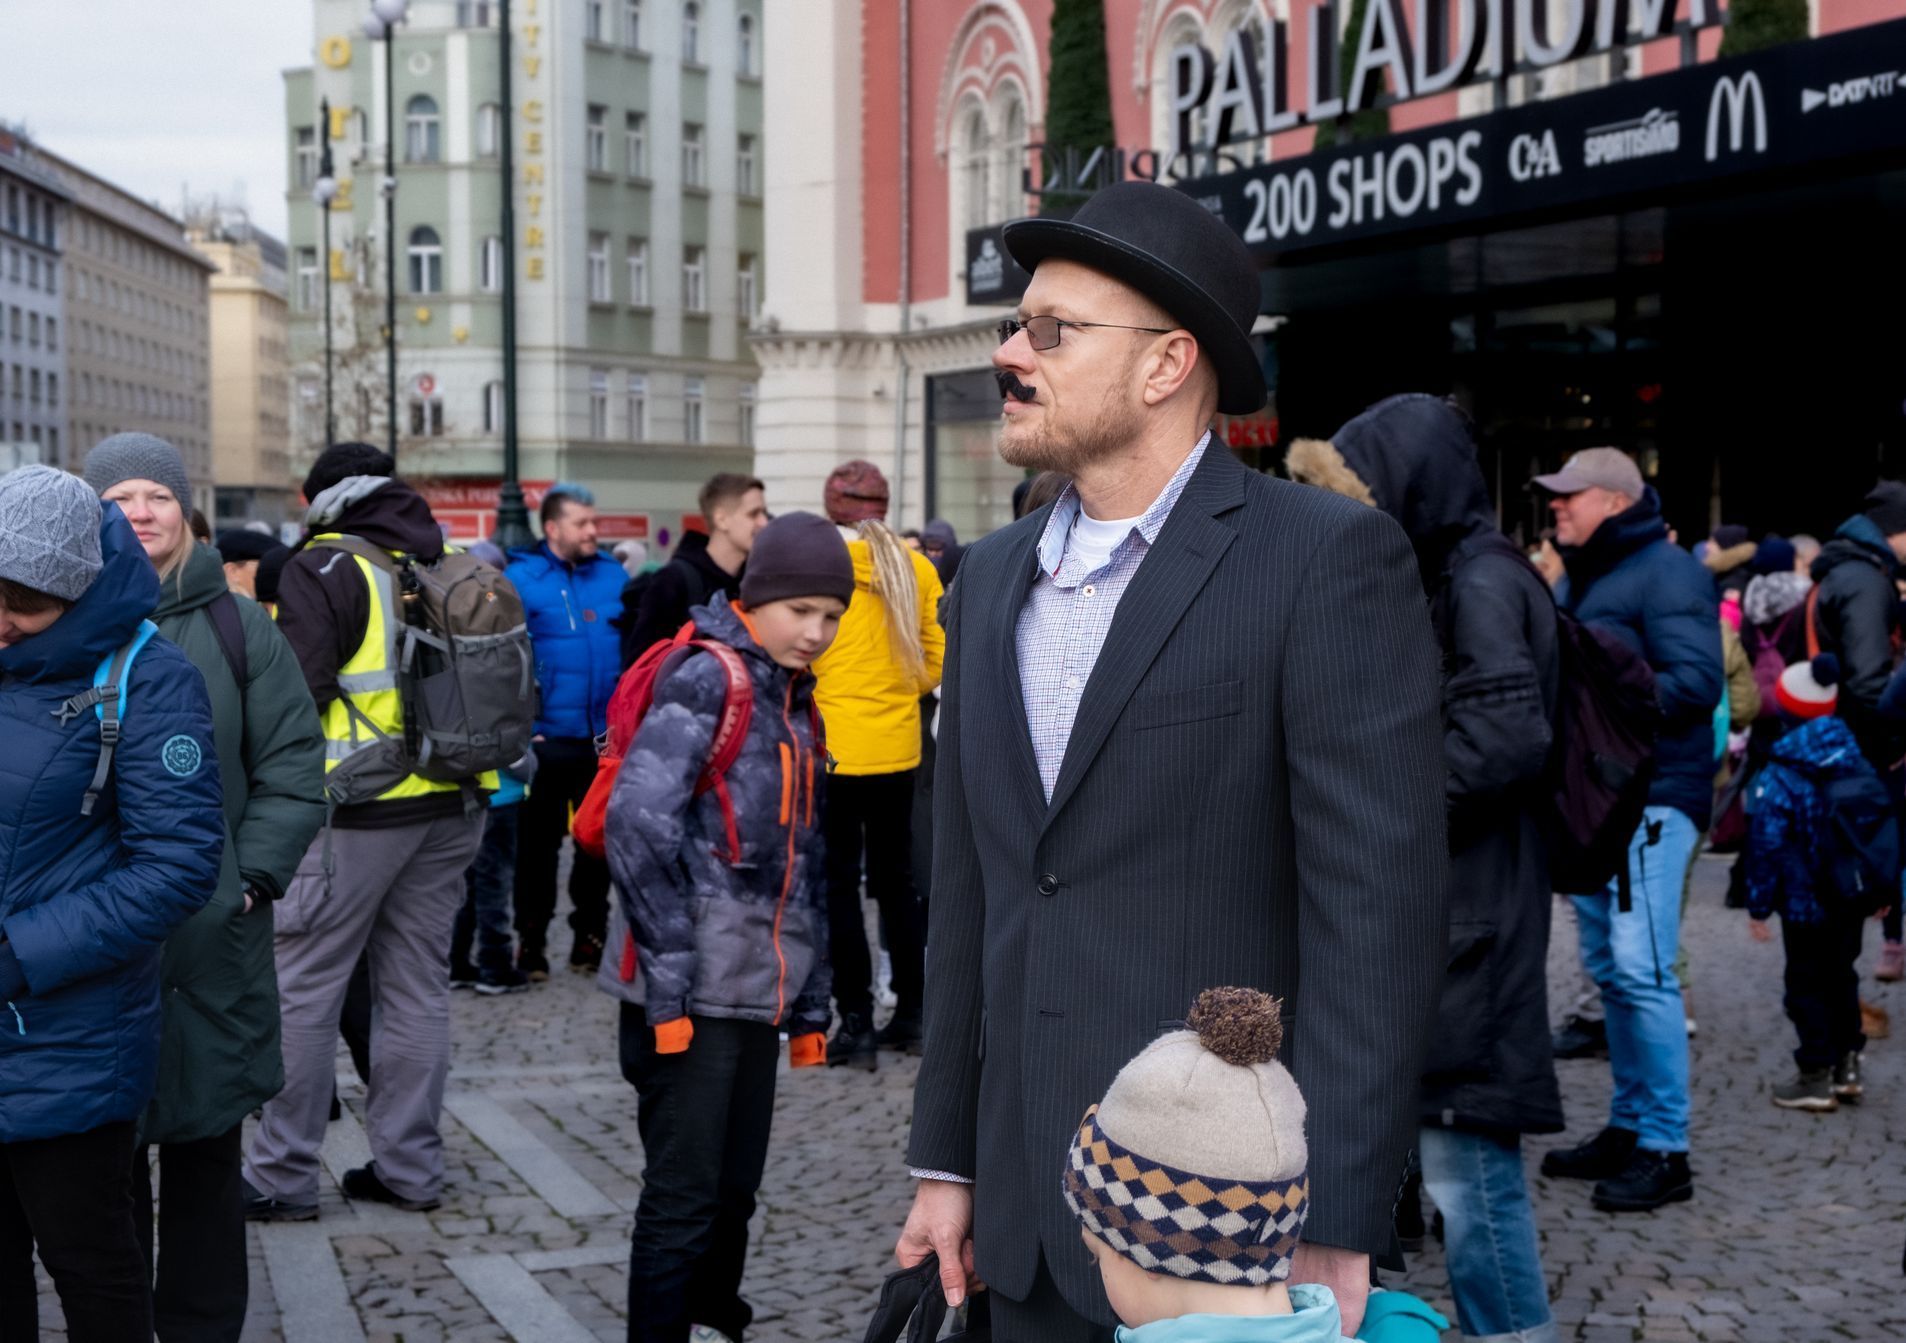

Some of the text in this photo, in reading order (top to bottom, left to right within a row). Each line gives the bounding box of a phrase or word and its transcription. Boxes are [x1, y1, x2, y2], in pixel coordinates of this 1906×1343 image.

[522, 100, 544, 281] CENTRE
[1243, 130, 1482, 243] 200 SHOPS
[1508, 129, 1562, 181] C&A
